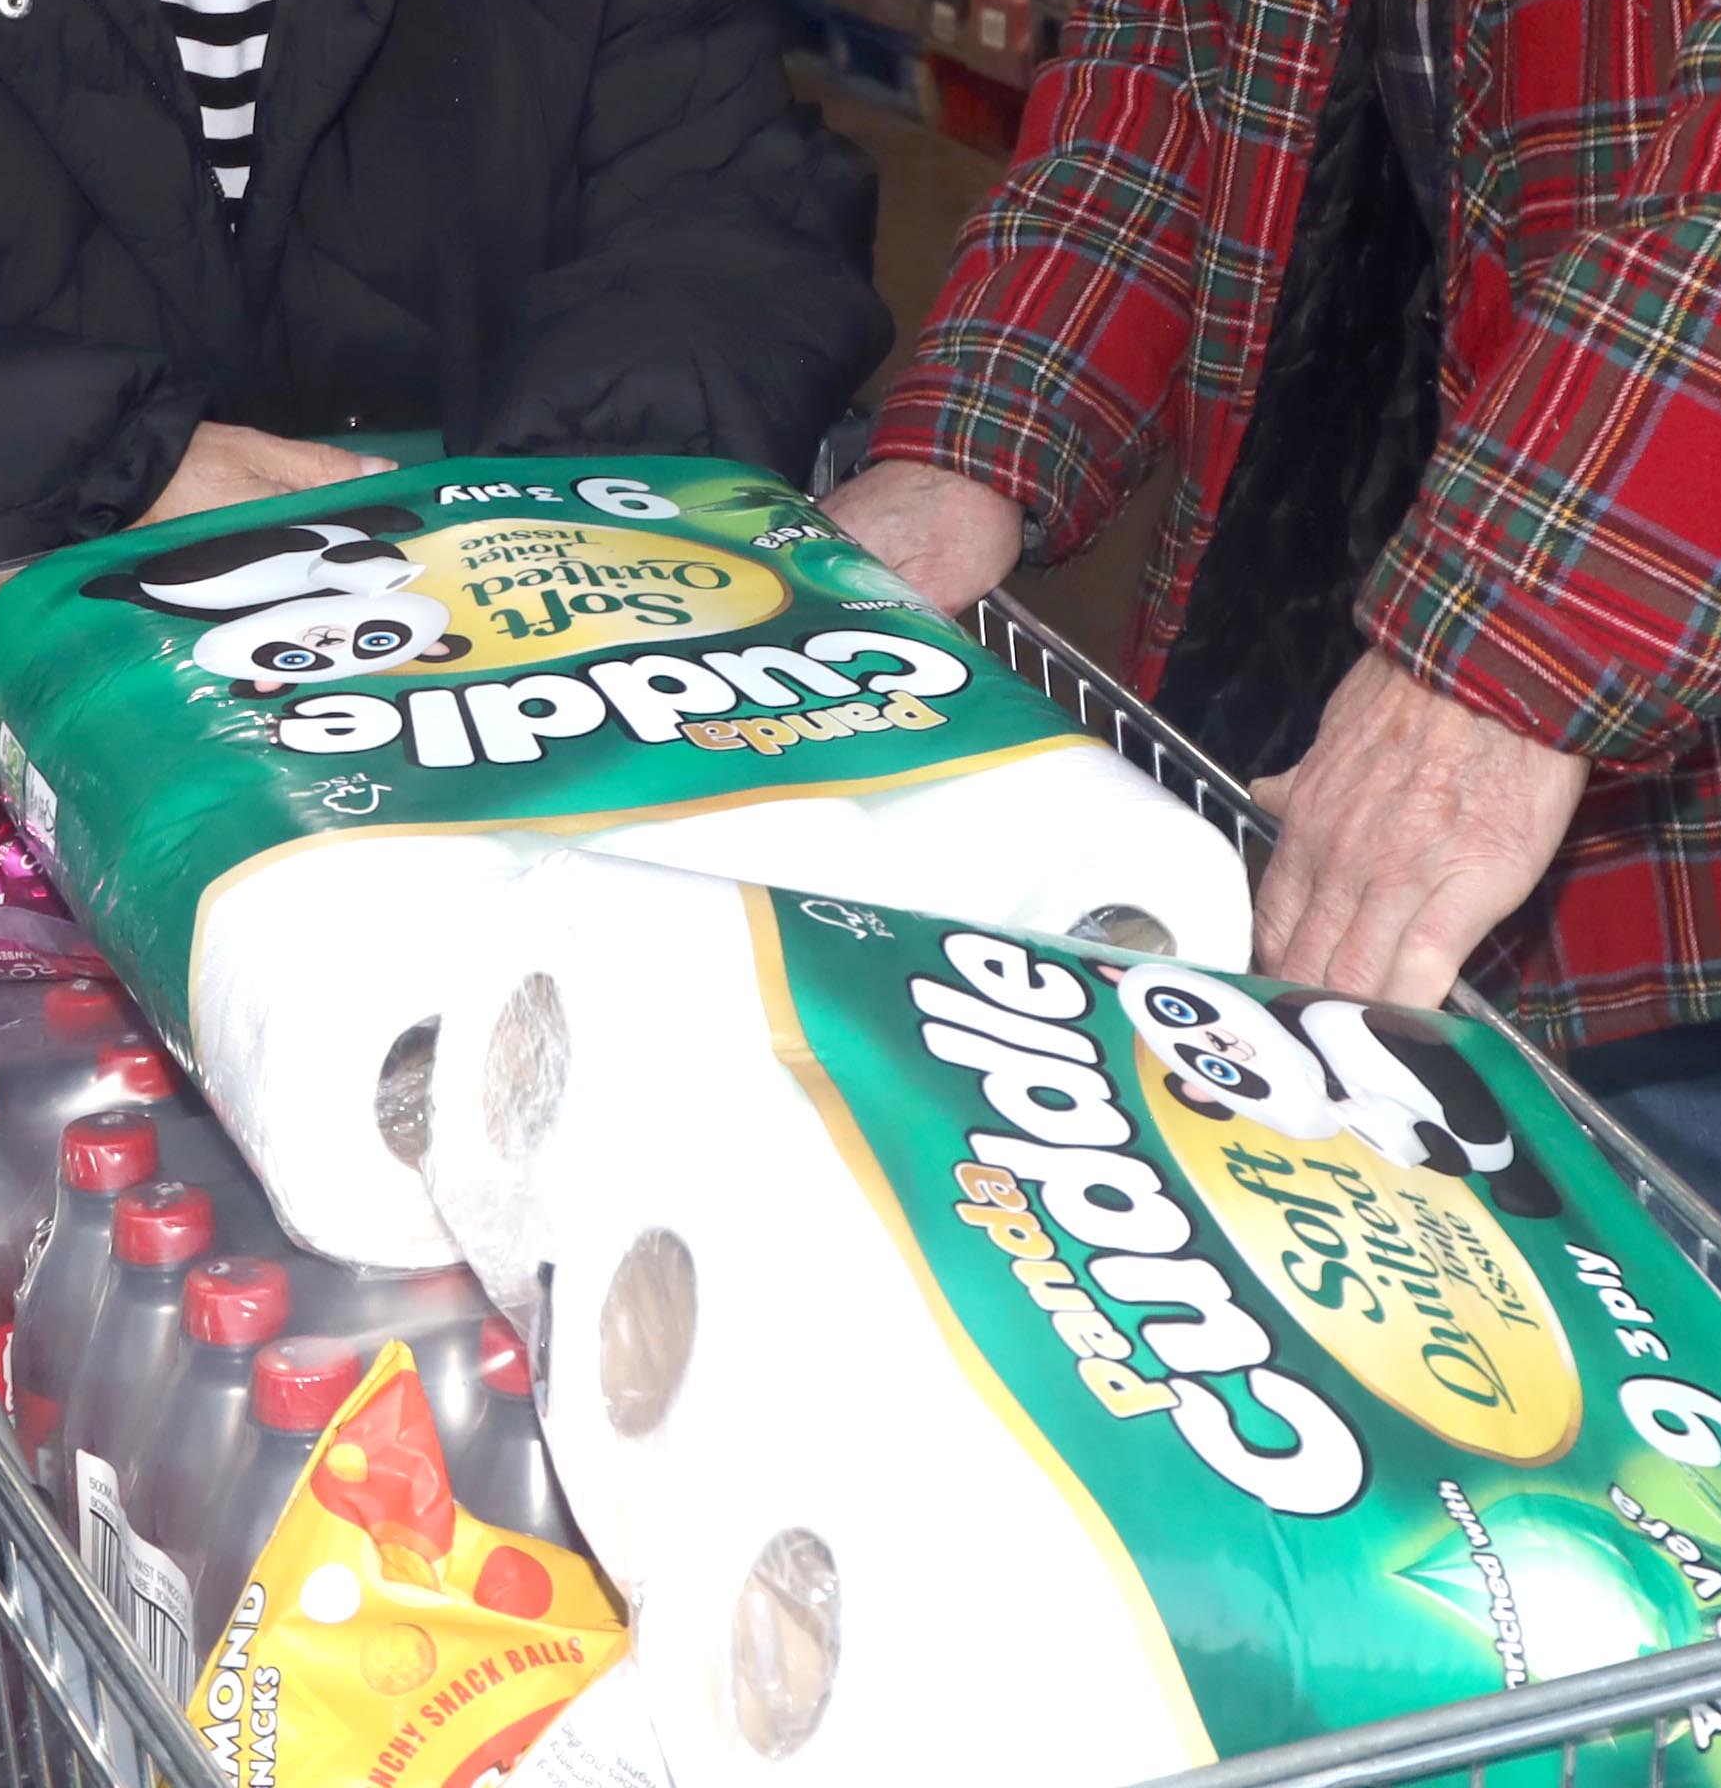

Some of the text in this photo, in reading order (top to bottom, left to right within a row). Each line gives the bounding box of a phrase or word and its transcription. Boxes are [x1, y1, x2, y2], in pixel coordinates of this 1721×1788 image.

[438, 476, 681, 520] 9 3 ply
[459, 529, 600, 550] Tissue
[752, 524, 832, 550] Vera
[460, 543, 583, 570] Toilet
[462, 557, 733, 606] Quilted
[490, 588, 693, 640] Soft
[279, 630, 970, 768] Cuddle
[680, 691, 951, 755] Panda
[909, 931, 1366, 1517] Cuddle
[1222, 1141, 1385, 1324] Soft
[1396, 1191, 1489, 1301] Toilet
[1443, 1211, 1540, 1331] Tissue
[953, 1161, 1181, 1418] Panda
[1304, 1158, 1515, 1413] Quilted
[1565, 1243, 1654, 1326] ply
[1617, 1327, 1669, 1363] 3
[1437, 1480, 1528, 1690] nriched with
[200, 1581, 267, 1788] MOND
[248, 1666, 281, 1788] NACKS
[366, 1722, 427, 1788] NCHY
[419, 1658, 505, 1727] SNACK
[504, 1636, 586, 1676] BALLS
